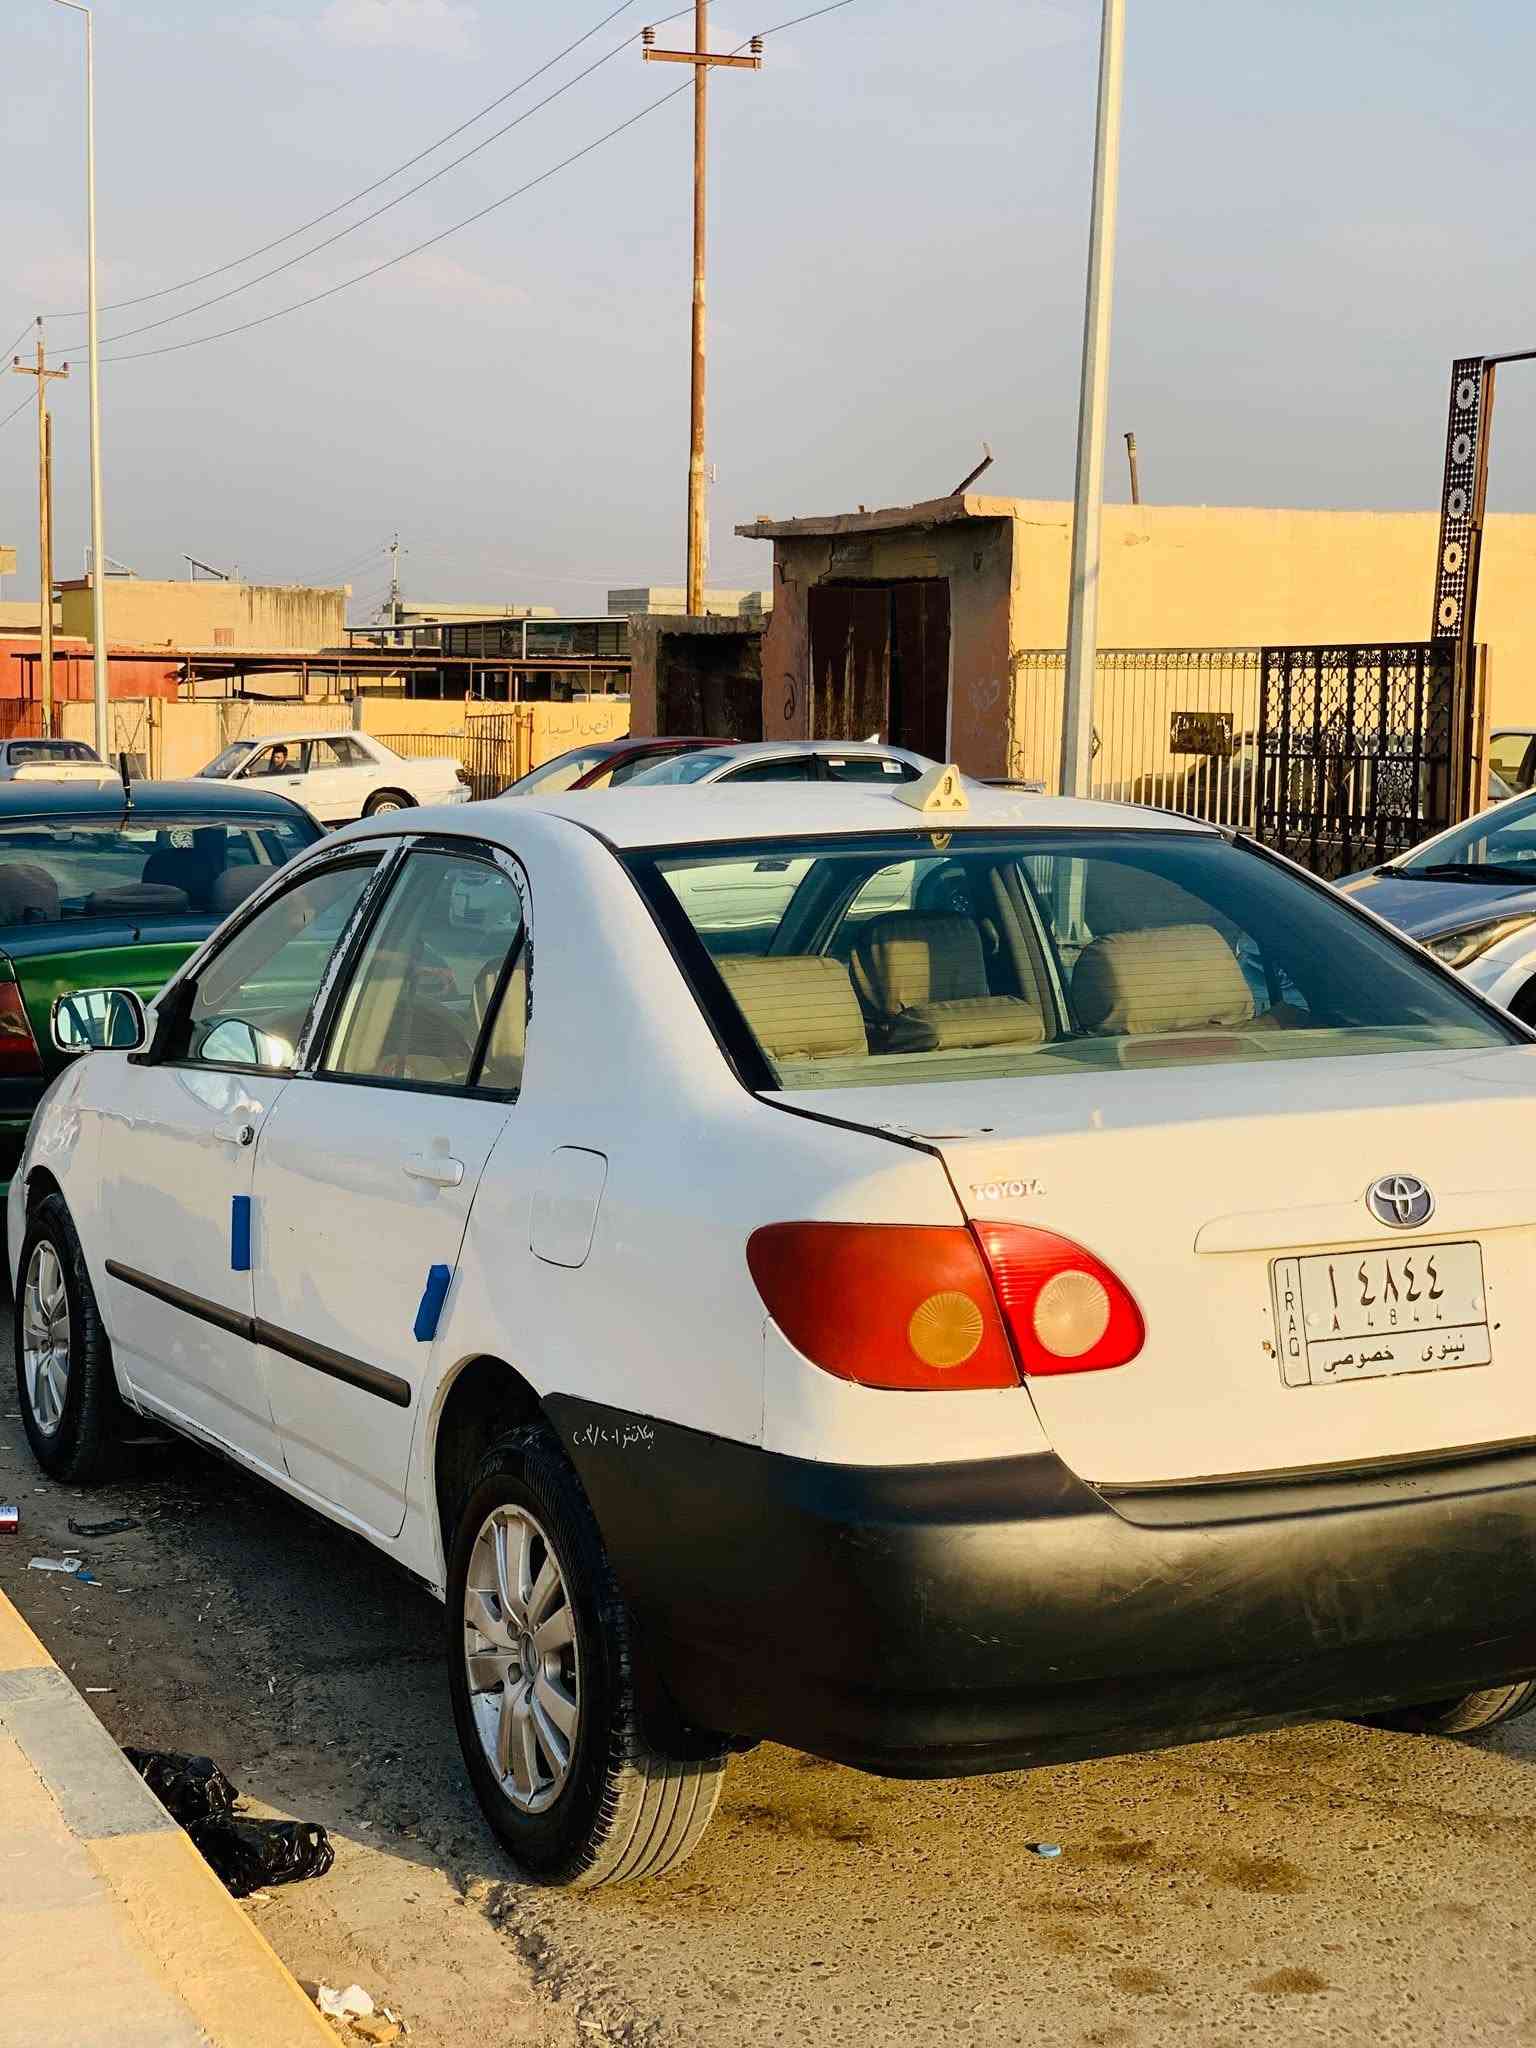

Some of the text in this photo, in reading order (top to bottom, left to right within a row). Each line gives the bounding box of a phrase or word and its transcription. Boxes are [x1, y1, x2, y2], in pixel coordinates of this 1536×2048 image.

[968, 1178, 1047, 1201] TOYOTA
[1284, 1267, 1300, 1357] IRAQ
[1323, 1344, 1395, 1375] خصوصي
